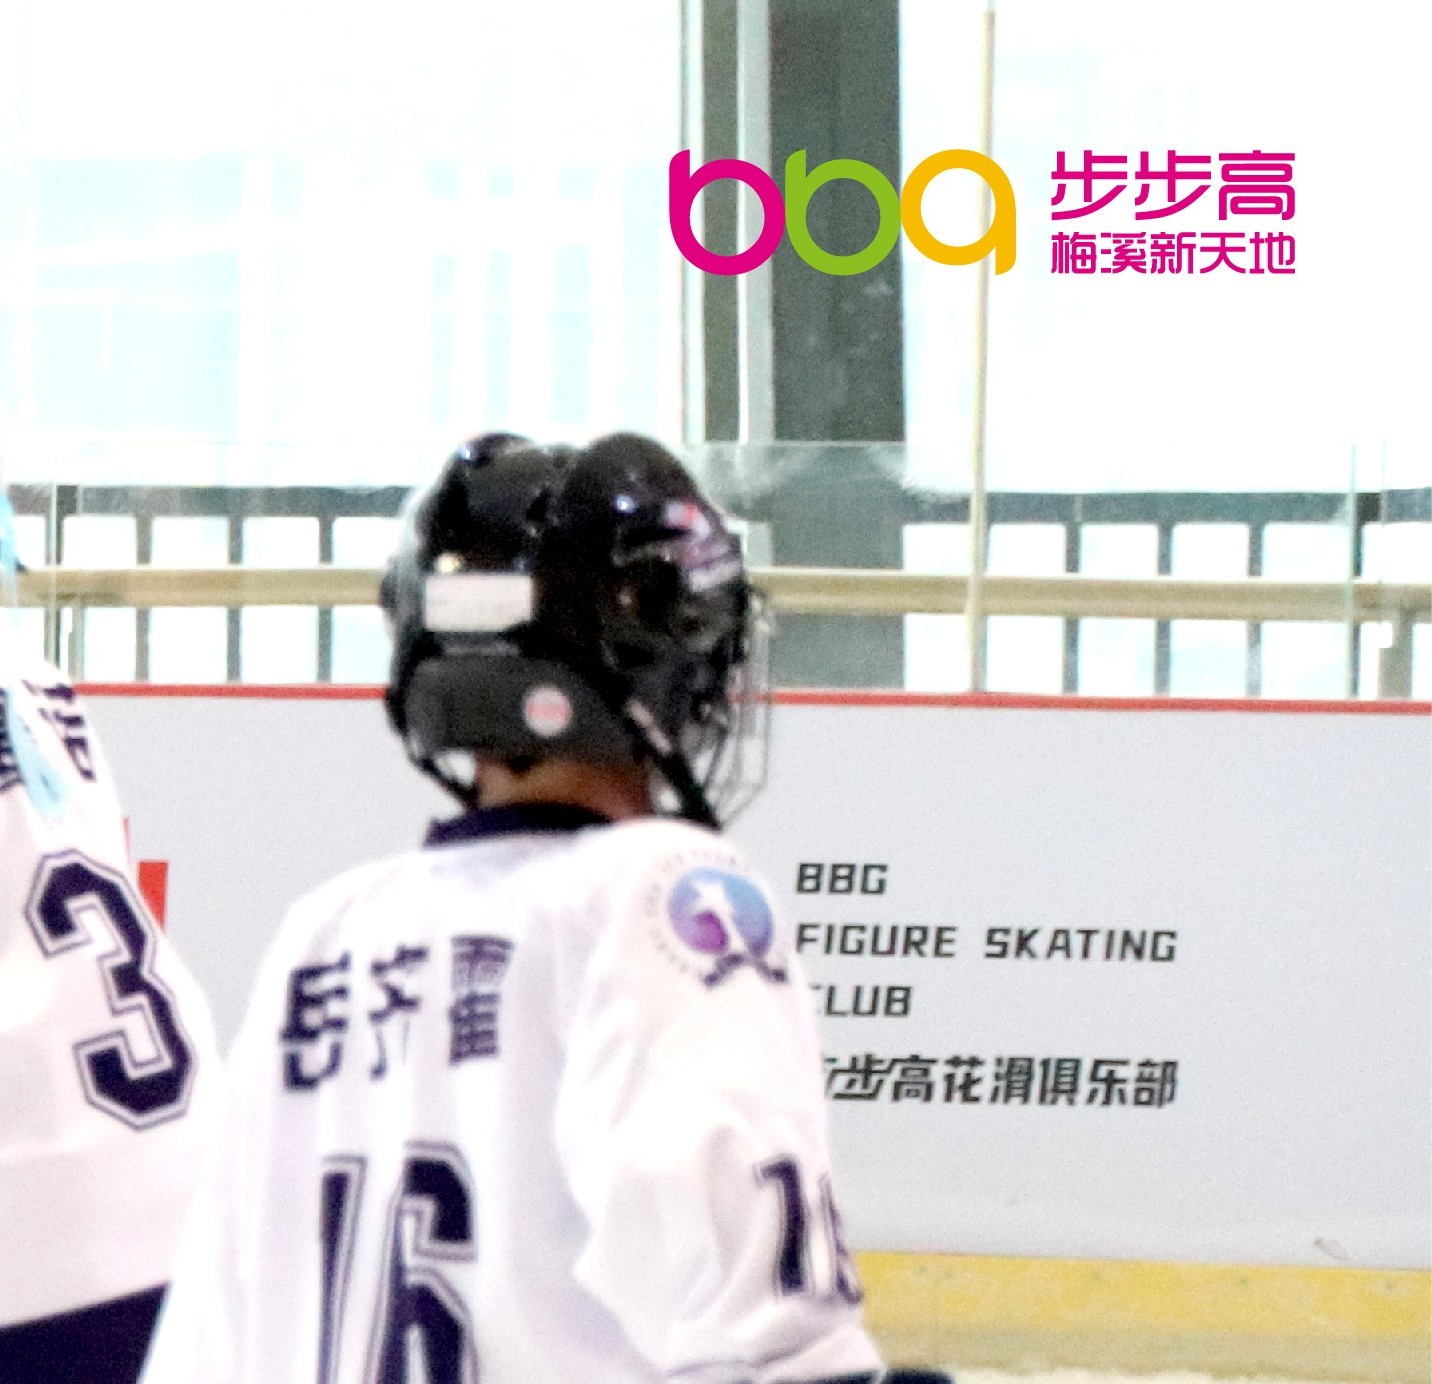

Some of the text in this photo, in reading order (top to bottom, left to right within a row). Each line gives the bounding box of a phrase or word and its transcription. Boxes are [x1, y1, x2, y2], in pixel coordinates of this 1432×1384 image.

[796, 862, 888, 896] BBG
[796, 923, 1179, 963] FIGURE SKATING
[25, 847, 200, 1132] 3
[809, 984, 914, 1019] LUB
[823, 1053, 1179, 1110] 步高花滑俱乐部
